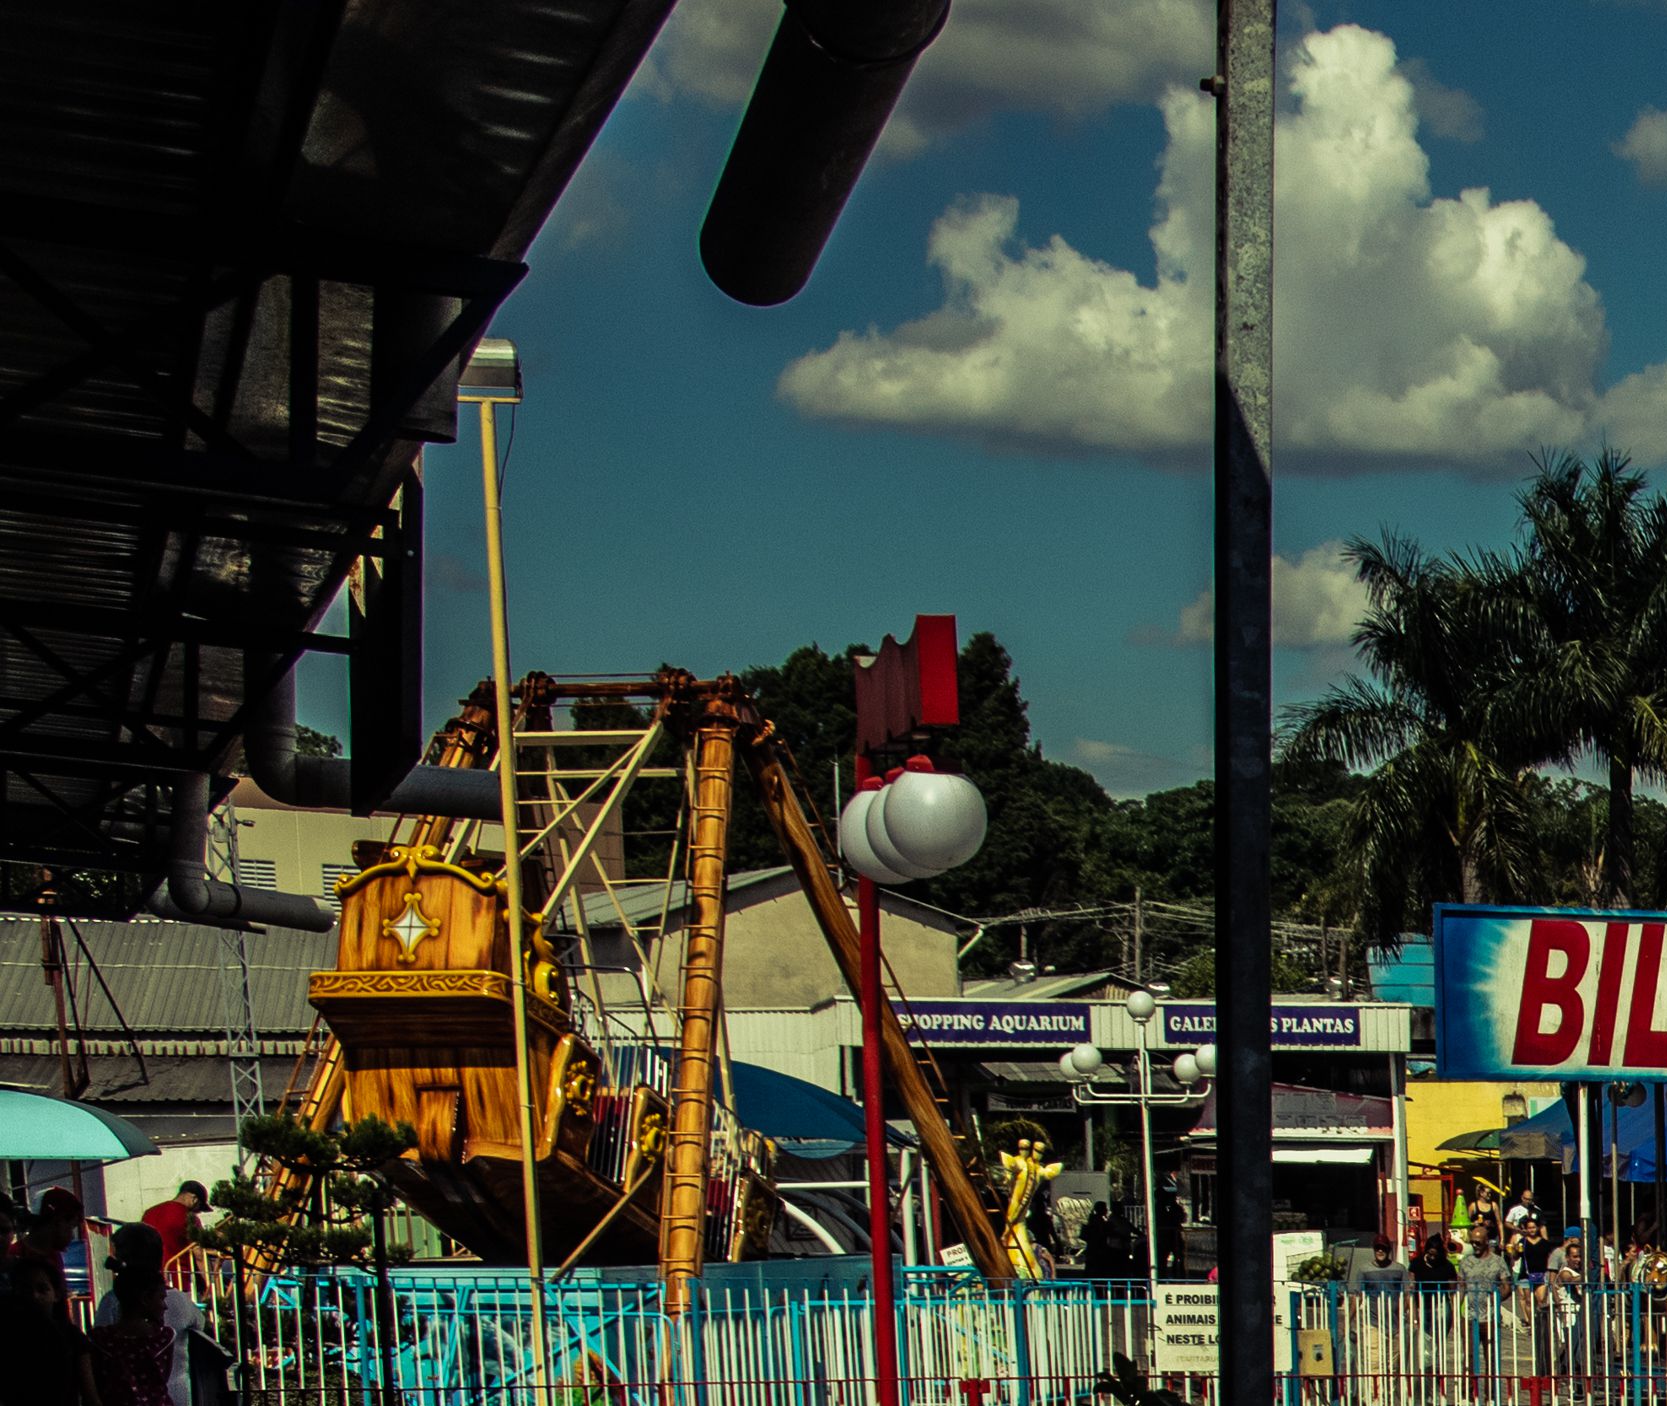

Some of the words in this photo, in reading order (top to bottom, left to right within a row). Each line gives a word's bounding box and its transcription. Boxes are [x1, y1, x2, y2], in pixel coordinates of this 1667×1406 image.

[897, 1013, 985, 1030] SHOPPING
[988, 1014, 1086, 1034] AQUARIUM
[1281, 1017, 1355, 1034] PLANTAS
[1165, 1292, 1173, 1305] É
[1166, 1314, 1216, 1325] ANIMAIS
[1166, 1334, 1205, 1345] NESTE
